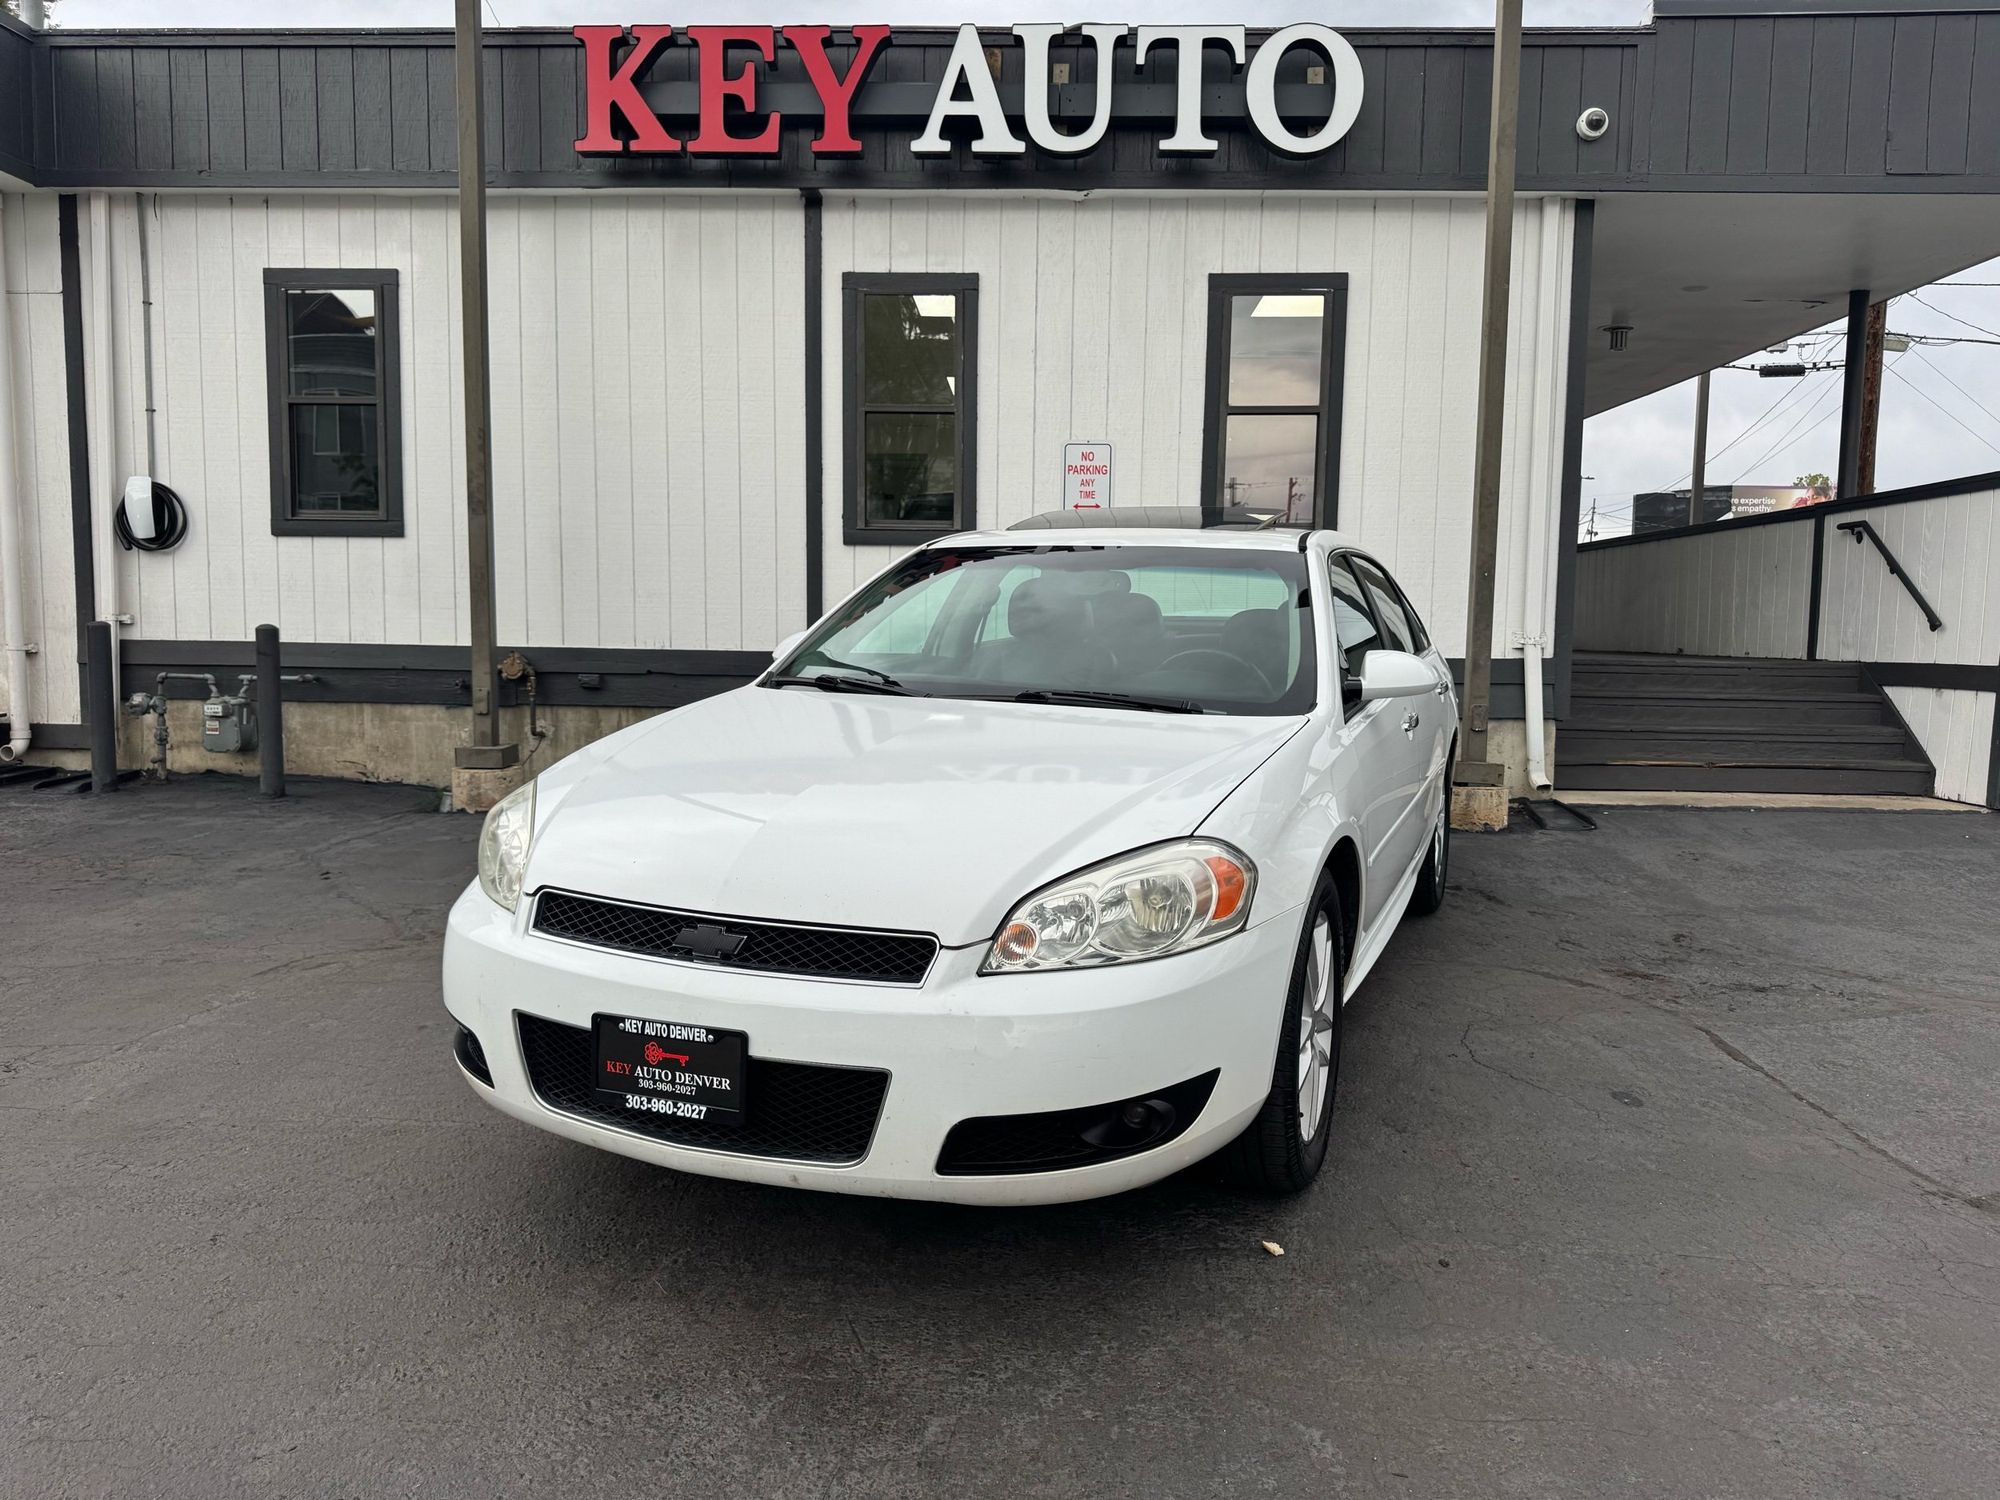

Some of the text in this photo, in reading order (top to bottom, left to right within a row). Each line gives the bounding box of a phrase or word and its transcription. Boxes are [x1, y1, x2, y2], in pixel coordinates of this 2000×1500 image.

[573, 23, 1365, 154] KEY AUTO
[1081, 451, 1095, 462] NO
[1067, 464, 1108, 475] PARKING
[1080, 478, 1095, 487] ANY
[1079, 490, 1096, 499] TIME
[1740, 497, 1776, 505] expertise
[625, 1018, 707, 1043] KEY AUTO DENVER
[606, 1060, 731, 1091] KEY AUTO DENVER
[638, 1078, 697, 1096] 303-960-2027
[625, 1094, 707, 1120] 303-960-2027
